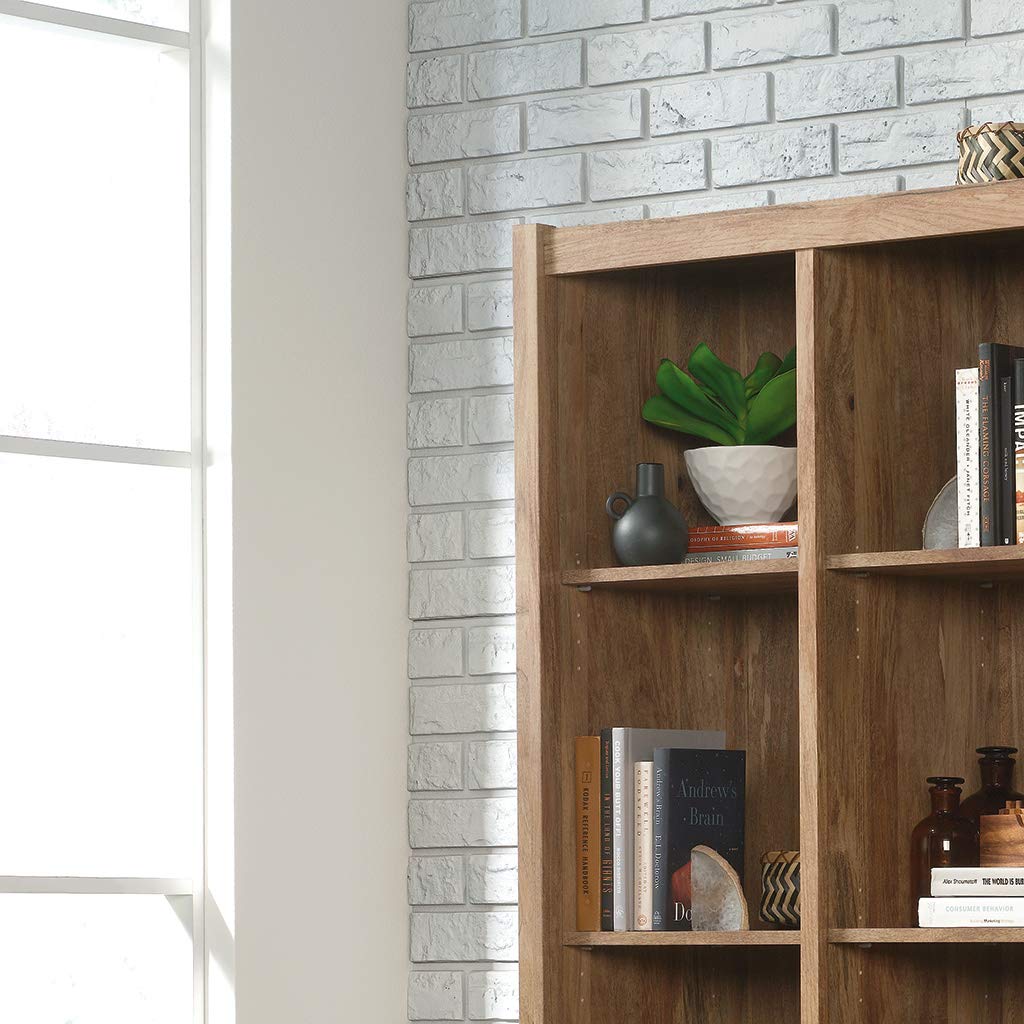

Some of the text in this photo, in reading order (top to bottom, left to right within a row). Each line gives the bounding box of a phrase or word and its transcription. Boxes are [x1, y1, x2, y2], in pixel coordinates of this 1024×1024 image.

[678, 778, 737, 799] Andrew's
[690, 807, 724, 826] Brain
[982, 878, 992, 886] THE
[992, 878, 1009, 886] WORLD
[1009, 878, 1014, 886] IS
